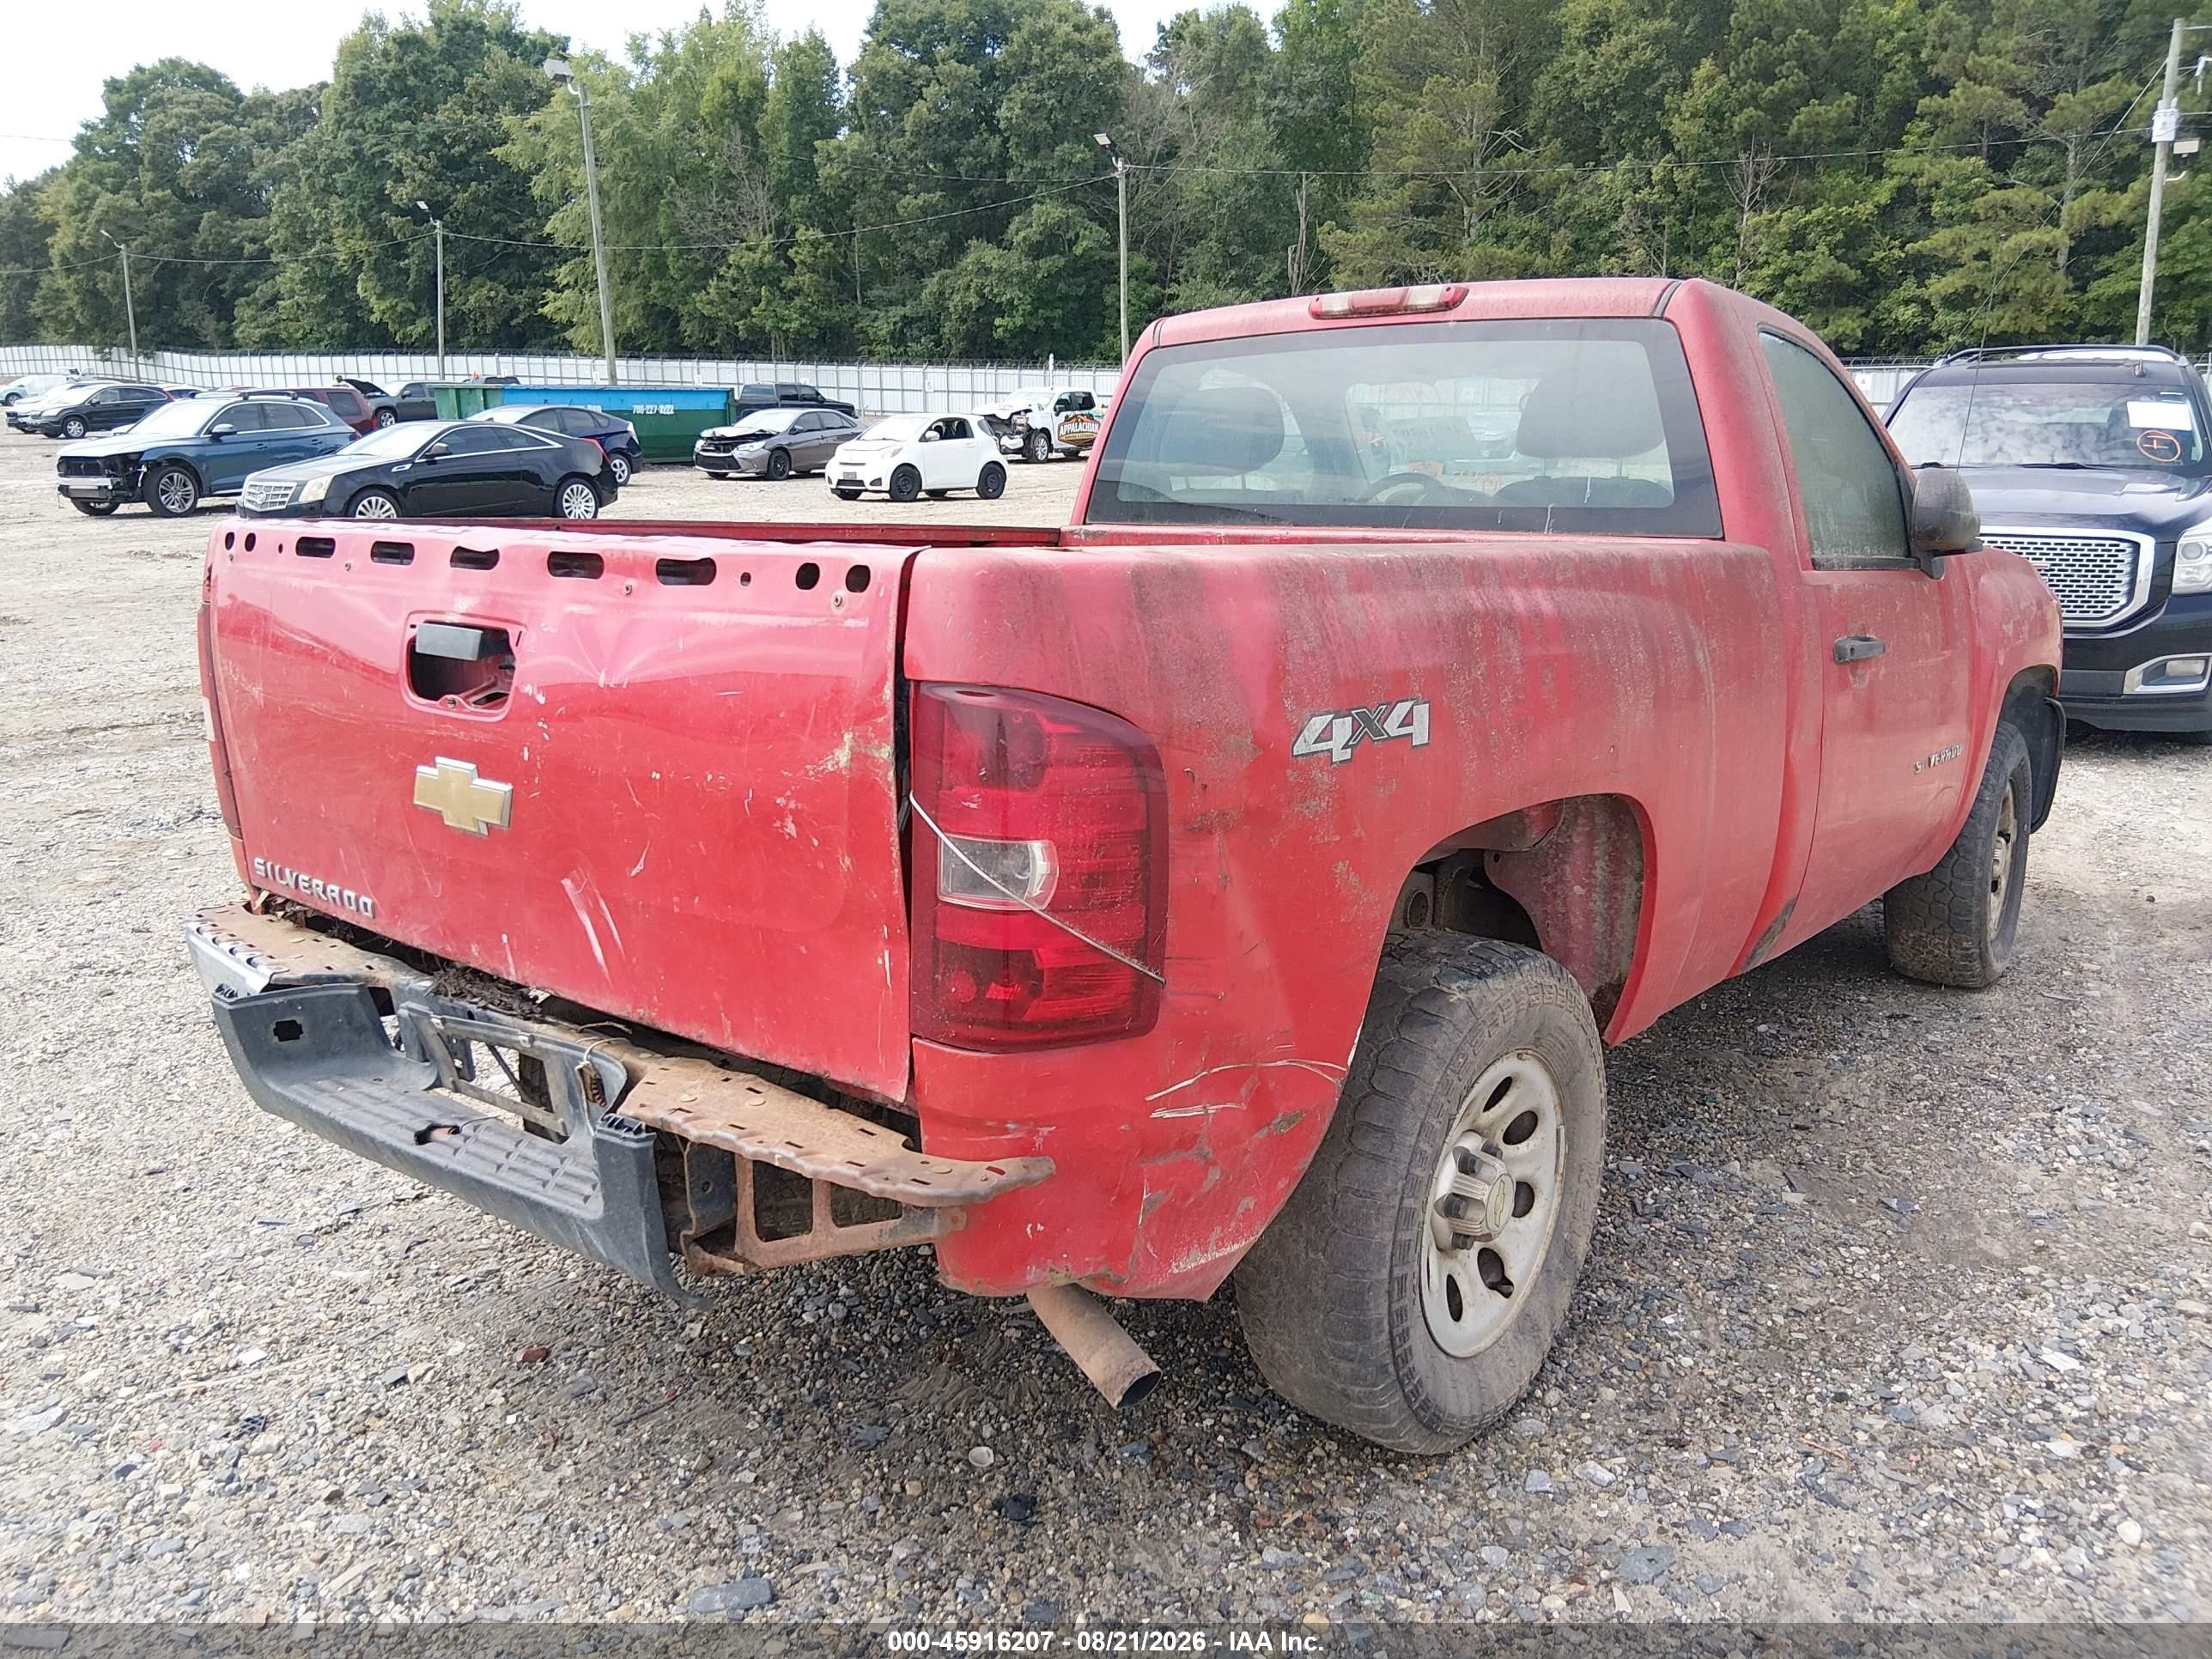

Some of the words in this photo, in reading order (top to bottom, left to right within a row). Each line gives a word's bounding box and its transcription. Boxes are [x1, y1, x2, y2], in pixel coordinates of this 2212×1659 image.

[1059, 422, 1100, 438] APPALACHIAN
[1913, 744, 1962, 775] SVERADO
[254, 857, 375, 919] SILVERADO
